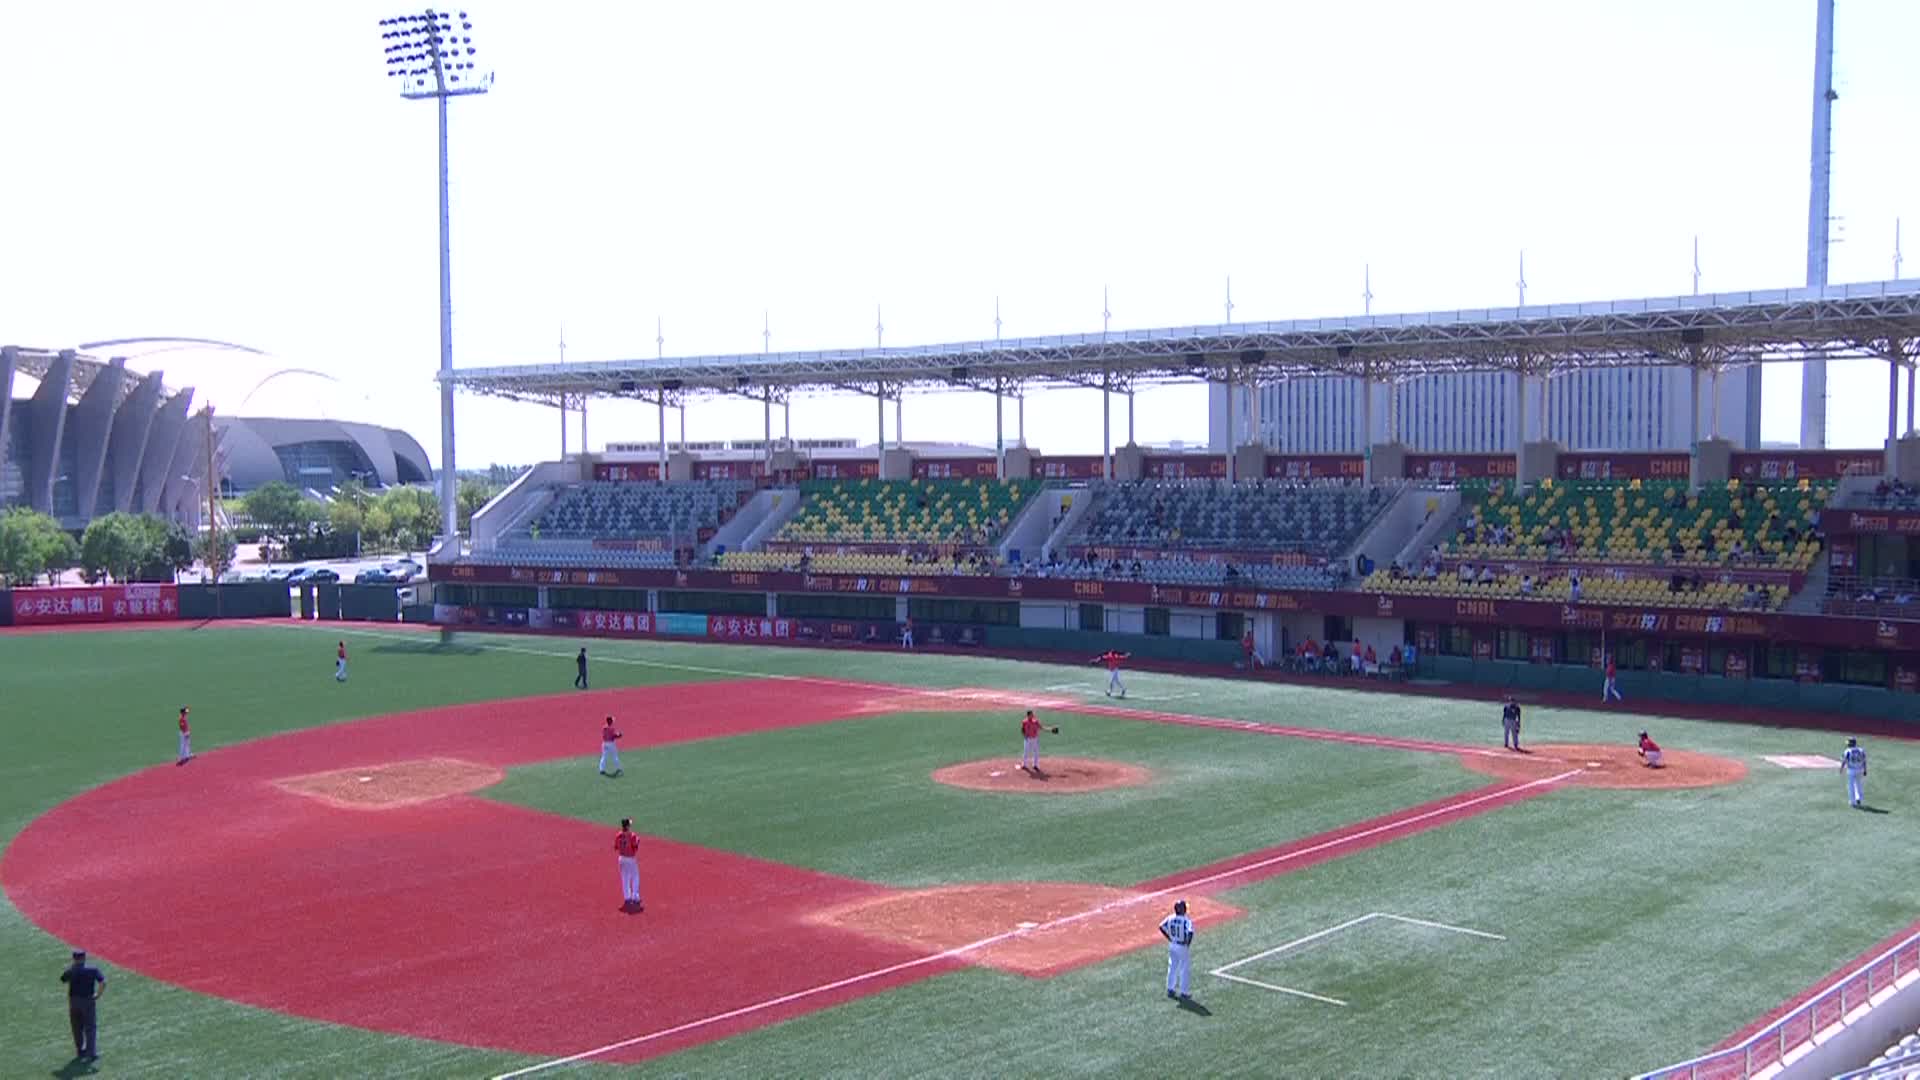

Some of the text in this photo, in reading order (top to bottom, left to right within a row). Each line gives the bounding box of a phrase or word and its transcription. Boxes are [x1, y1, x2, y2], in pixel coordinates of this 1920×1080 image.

[35, 596, 103, 616] 安达集团
[1456, 600, 1497, 616] CNBL
[595, 614, 650, 634] 安达集团
[728, 620, 790, 638] 安达集团
